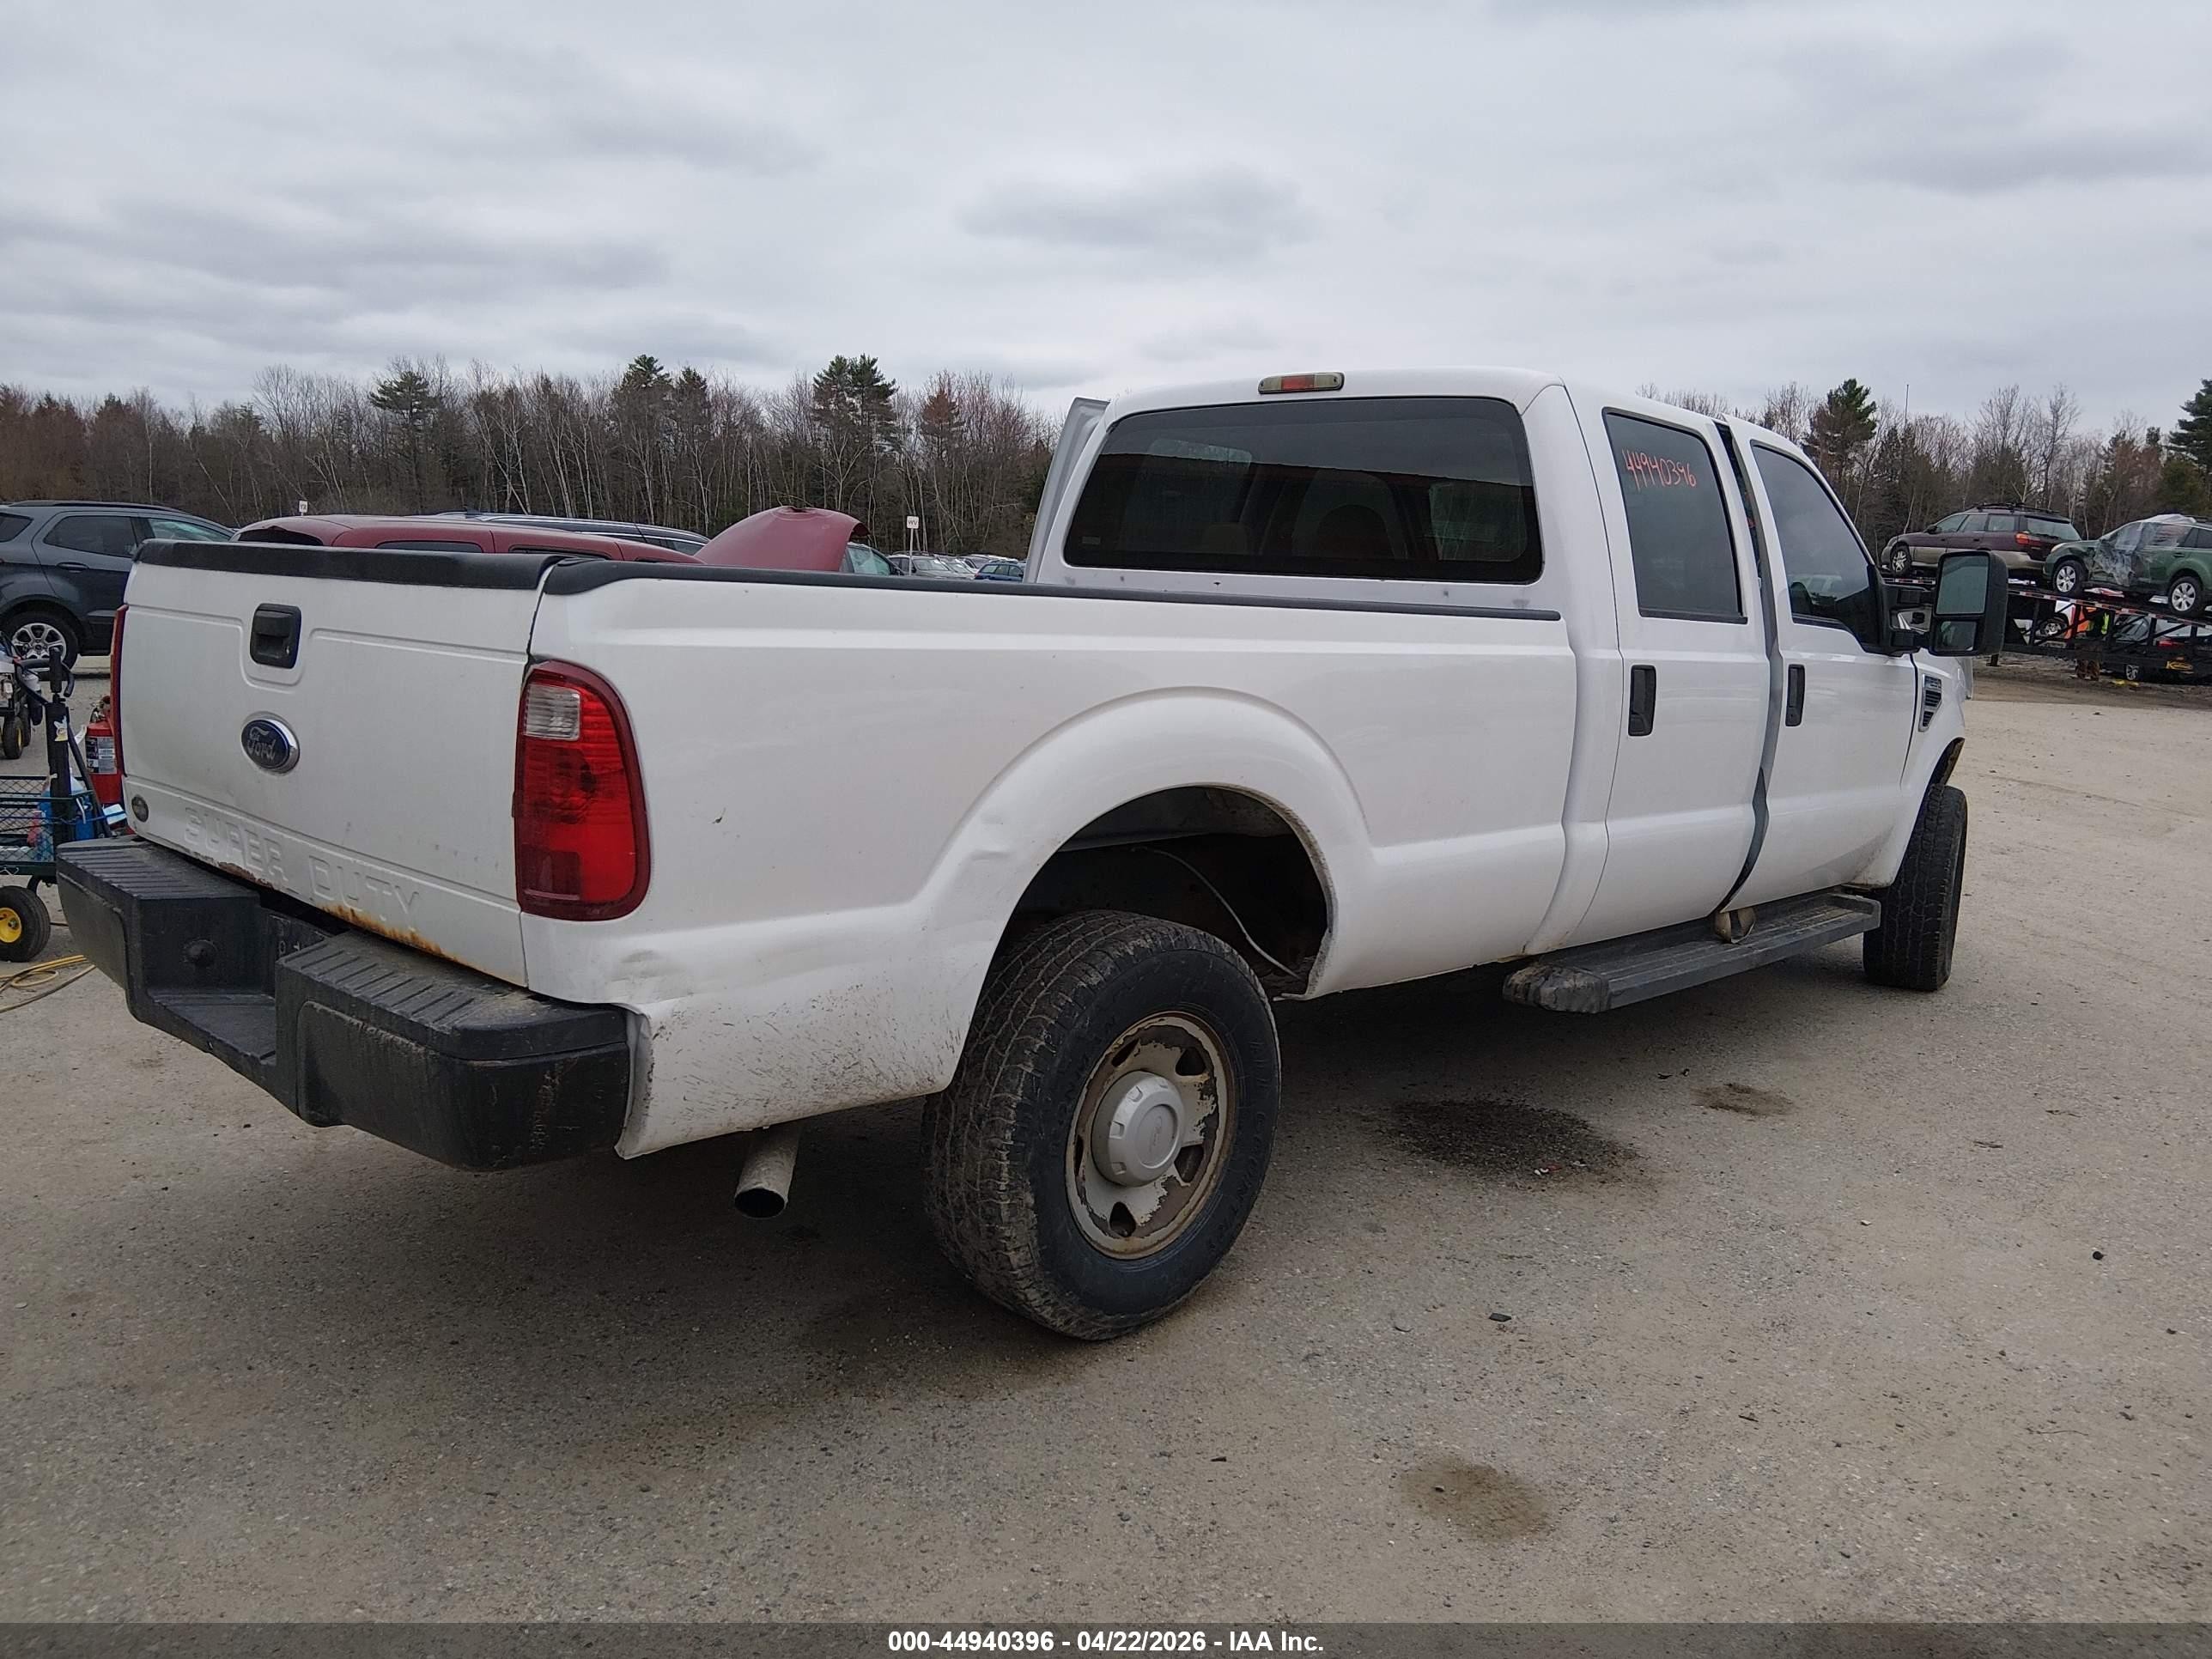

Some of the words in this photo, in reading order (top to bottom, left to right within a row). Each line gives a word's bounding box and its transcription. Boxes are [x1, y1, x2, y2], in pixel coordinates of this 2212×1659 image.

[1621, 448, 1697, 492] 44940396
[246, 726, 276, 761] Ford
[183, 806, 290, 884] SUPER
[308, 854, 420, 932] DUTY
